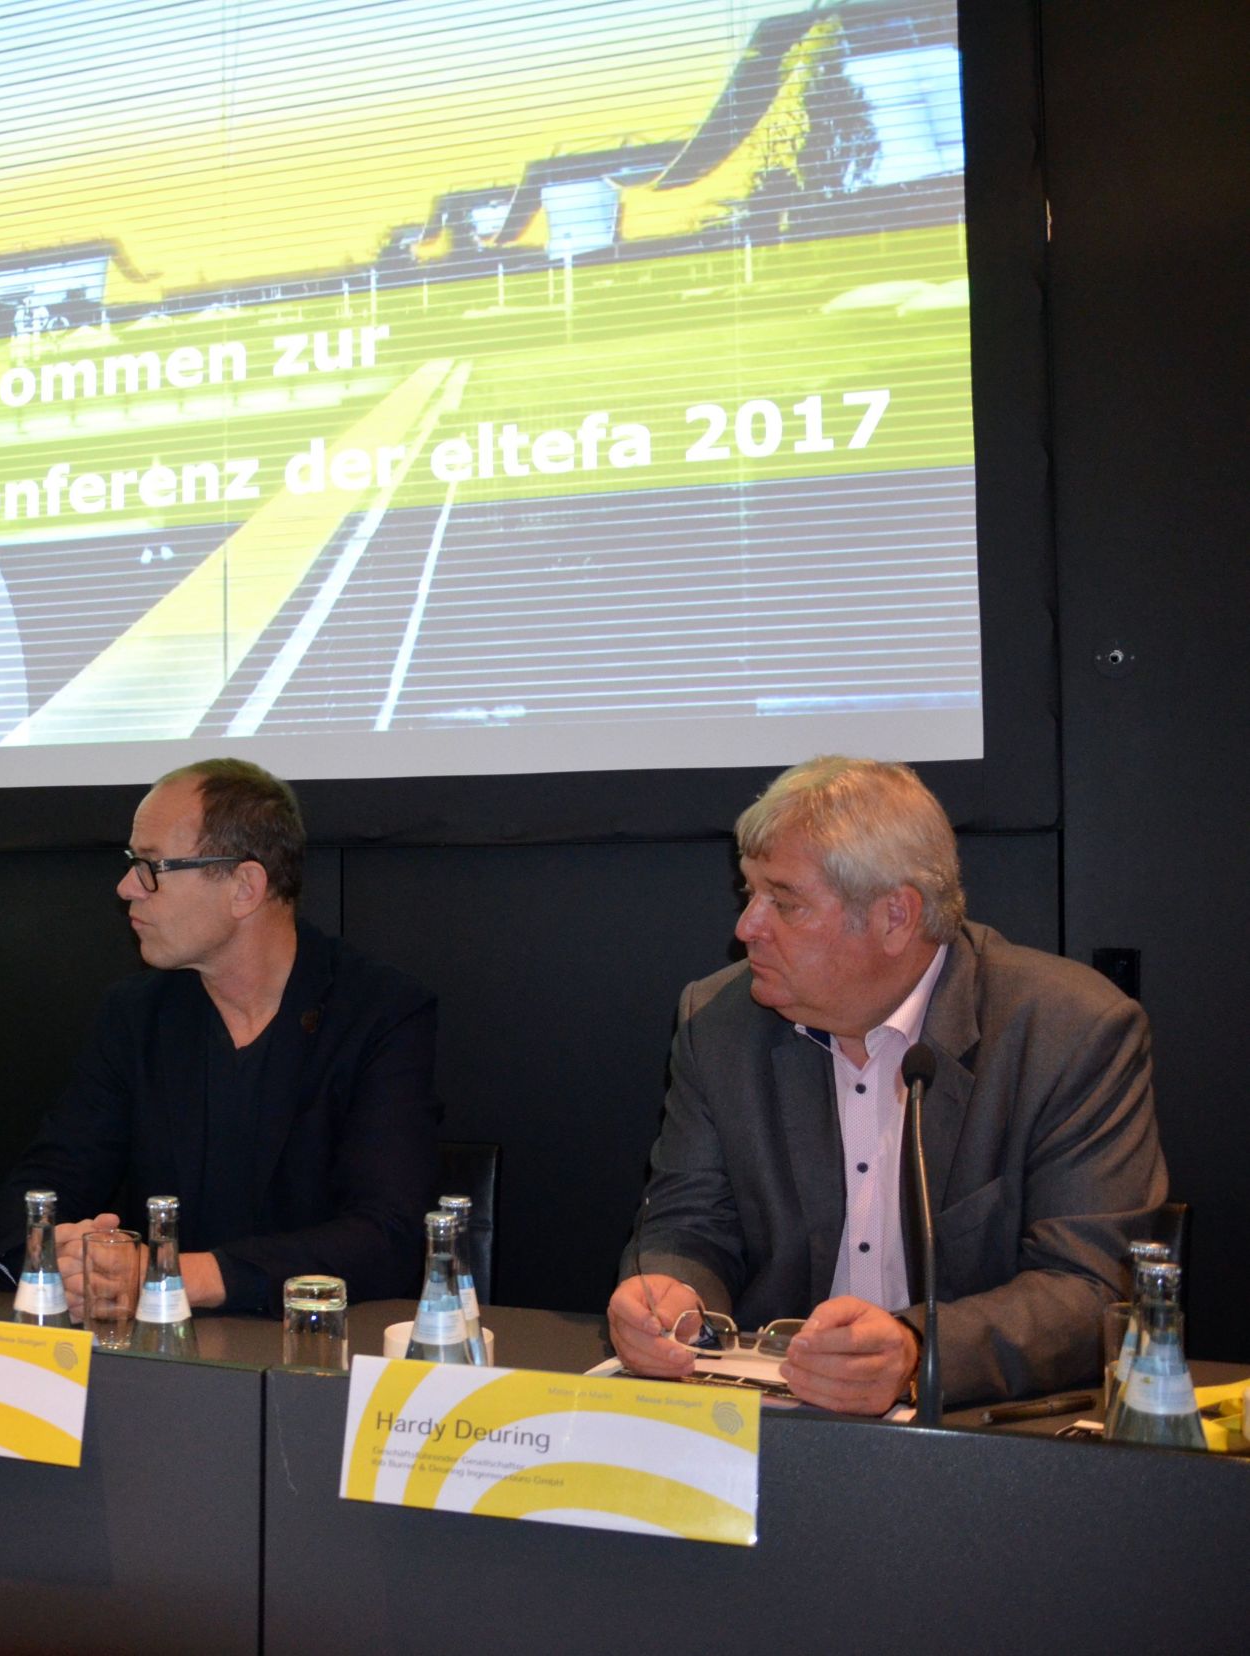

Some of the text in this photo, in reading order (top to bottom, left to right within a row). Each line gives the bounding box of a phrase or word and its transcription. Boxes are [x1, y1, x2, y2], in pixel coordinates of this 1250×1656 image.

[274, 325, 390, 375] zur
[285, 439, 405, 496] der
[430, 414, 652, 482] eltefa
[685, 390, 891, 463] 2017
[376, 1411, 550, 1453] Hardy Deuring
